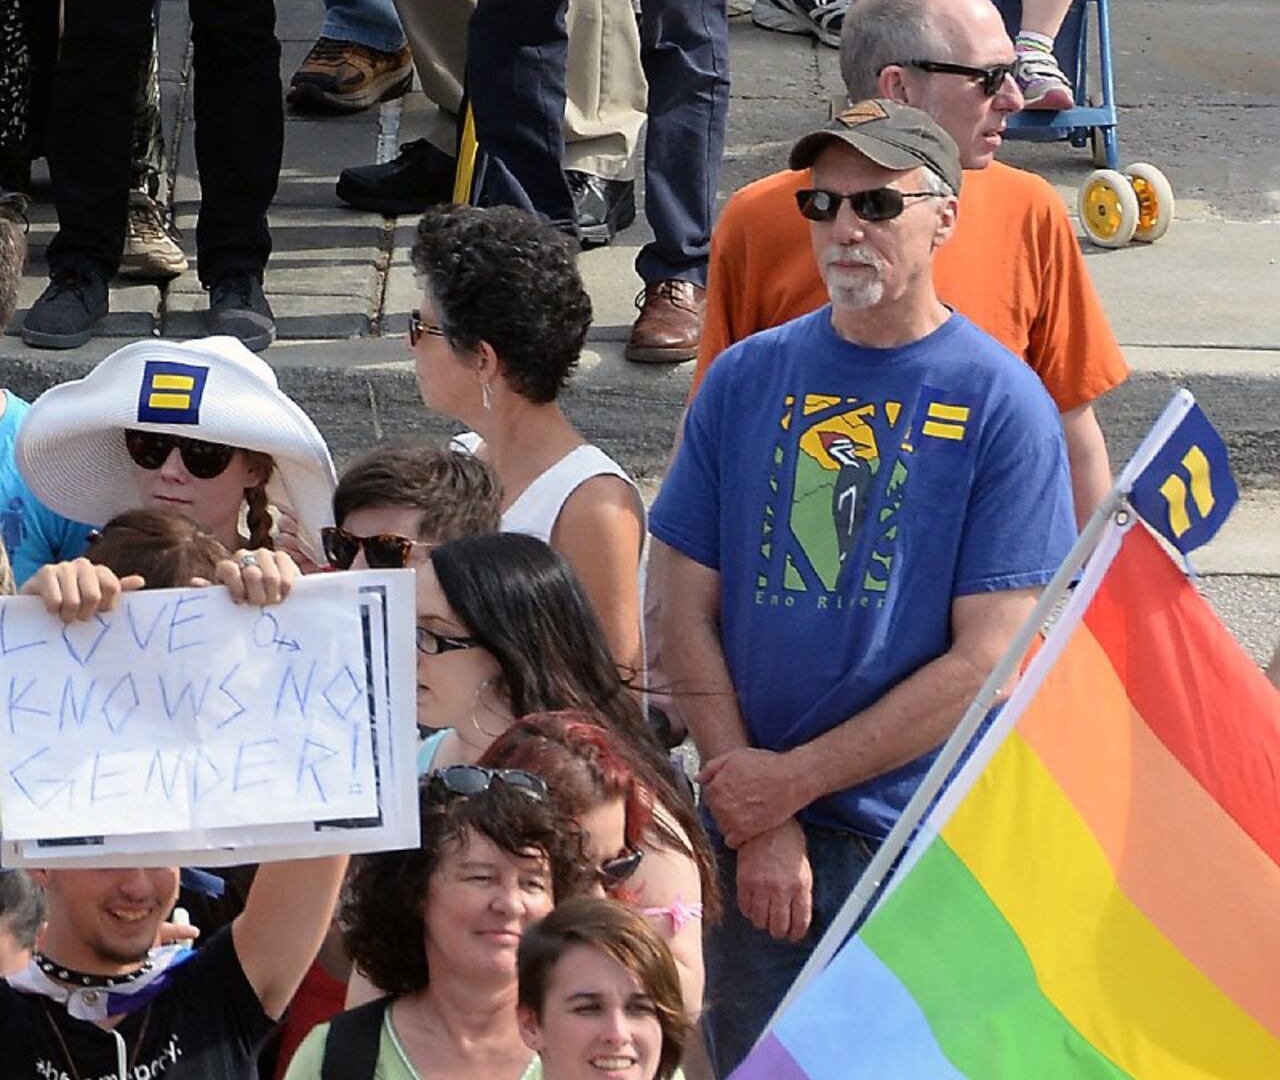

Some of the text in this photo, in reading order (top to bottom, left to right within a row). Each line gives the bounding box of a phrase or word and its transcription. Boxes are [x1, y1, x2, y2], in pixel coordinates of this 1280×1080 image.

[0, 595, 209, 668] LOVE
[755, 592, 886, 610] Eno Rier
[8, 660, 363, 734] KNOWS NO
[9, 723, 363, 811] GENDER!
